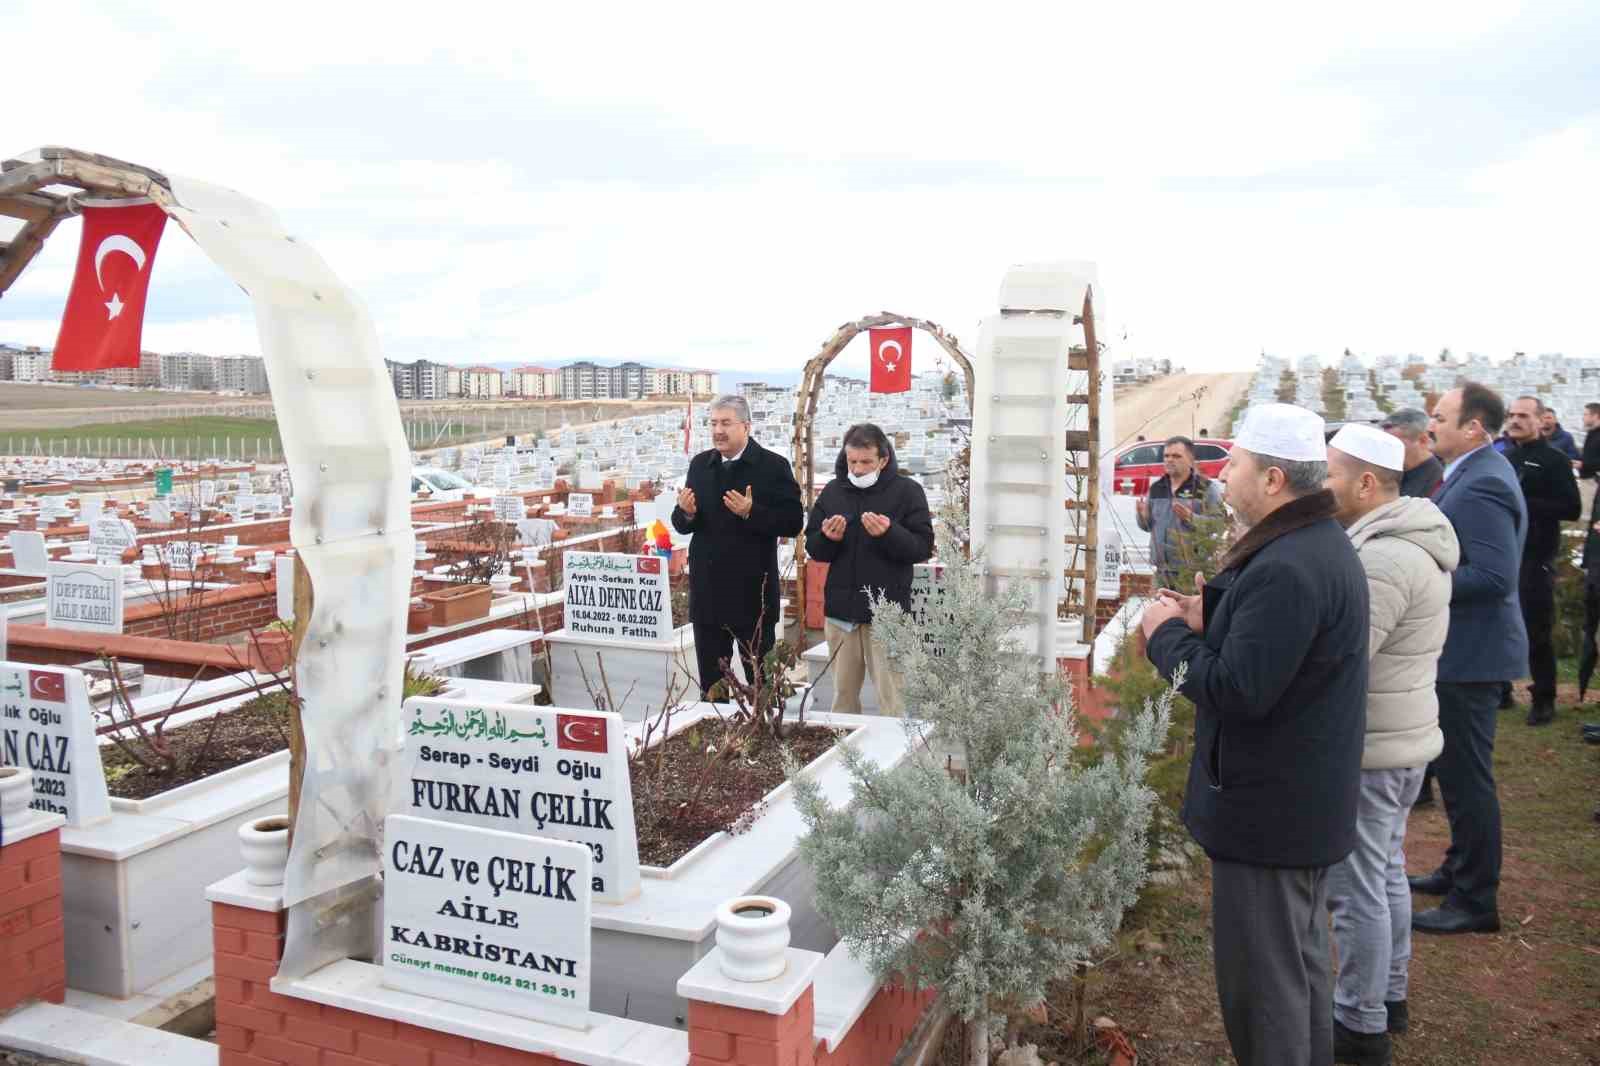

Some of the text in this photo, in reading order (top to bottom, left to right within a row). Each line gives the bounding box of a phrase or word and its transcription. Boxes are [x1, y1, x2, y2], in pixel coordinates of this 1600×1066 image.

[567, 584, 662, 612] ALYA DEFNE CAZ
[571, 622, 657, 638] Ruhuna Fatiha
[29, 707, 61, 726] Oğlu
[26, 731, 70, 774] CAZ
[420, 745, 471, 768] Serap
[488, 752, 539, 774] Seydi
[557, 759, 601, 781] Oğlu
[411, 778, 614, 830] FURKAN ÇELİK
[392, 840, 444, 878] CAZ
[451, 857, 479, 885] ve
[487, 855, 576, 901] ÇELİK
[437, 895, 519, 929] AİLE
[390, 925, 577, 978] KABRİSTANI
[391, 953, 430, 969] Cüneyt
[434, 962, 480, 980] mermer
[481, 971, 511, 986] 0542
[561, 987, 576, 999] 31
